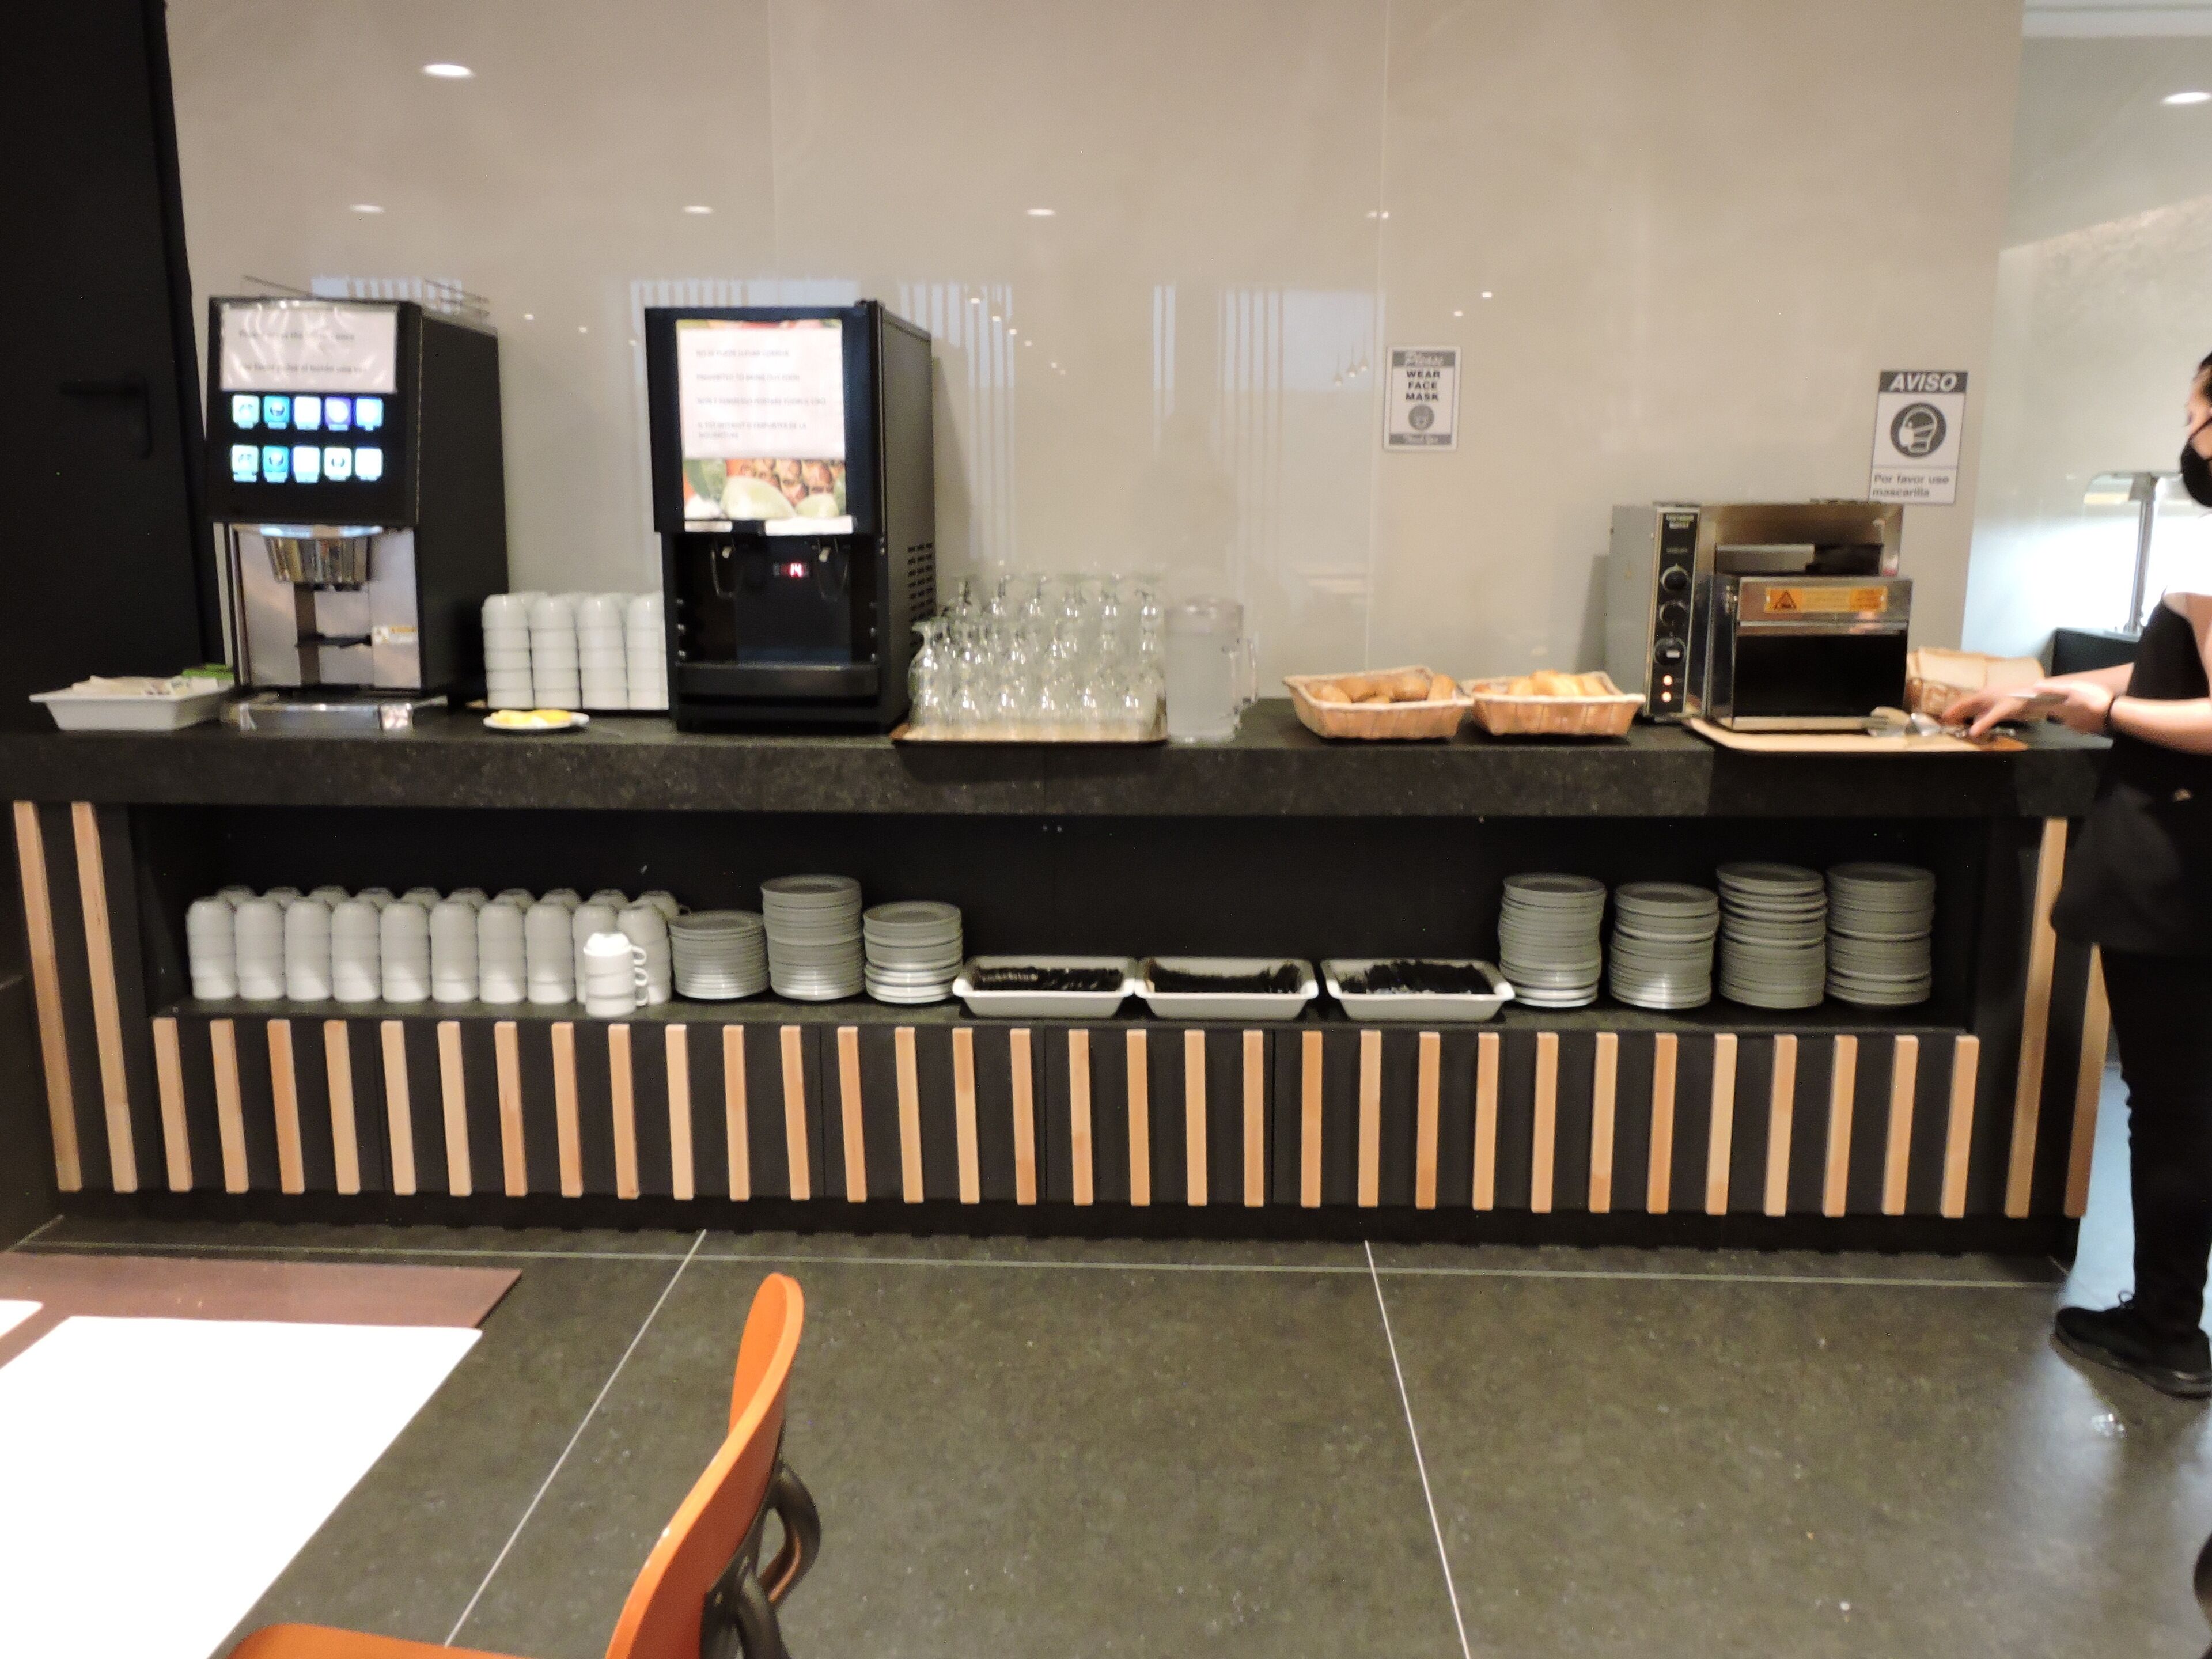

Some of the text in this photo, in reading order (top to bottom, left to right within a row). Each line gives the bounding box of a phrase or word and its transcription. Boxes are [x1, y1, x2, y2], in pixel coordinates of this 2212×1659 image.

[1889, 373, 1958, 392] AVISO
[1406, 393, 1439, 401] MASK
[1874, 474, 1949, 484] Por favor use
[1872, 488, 1930, 497] mascarilla
